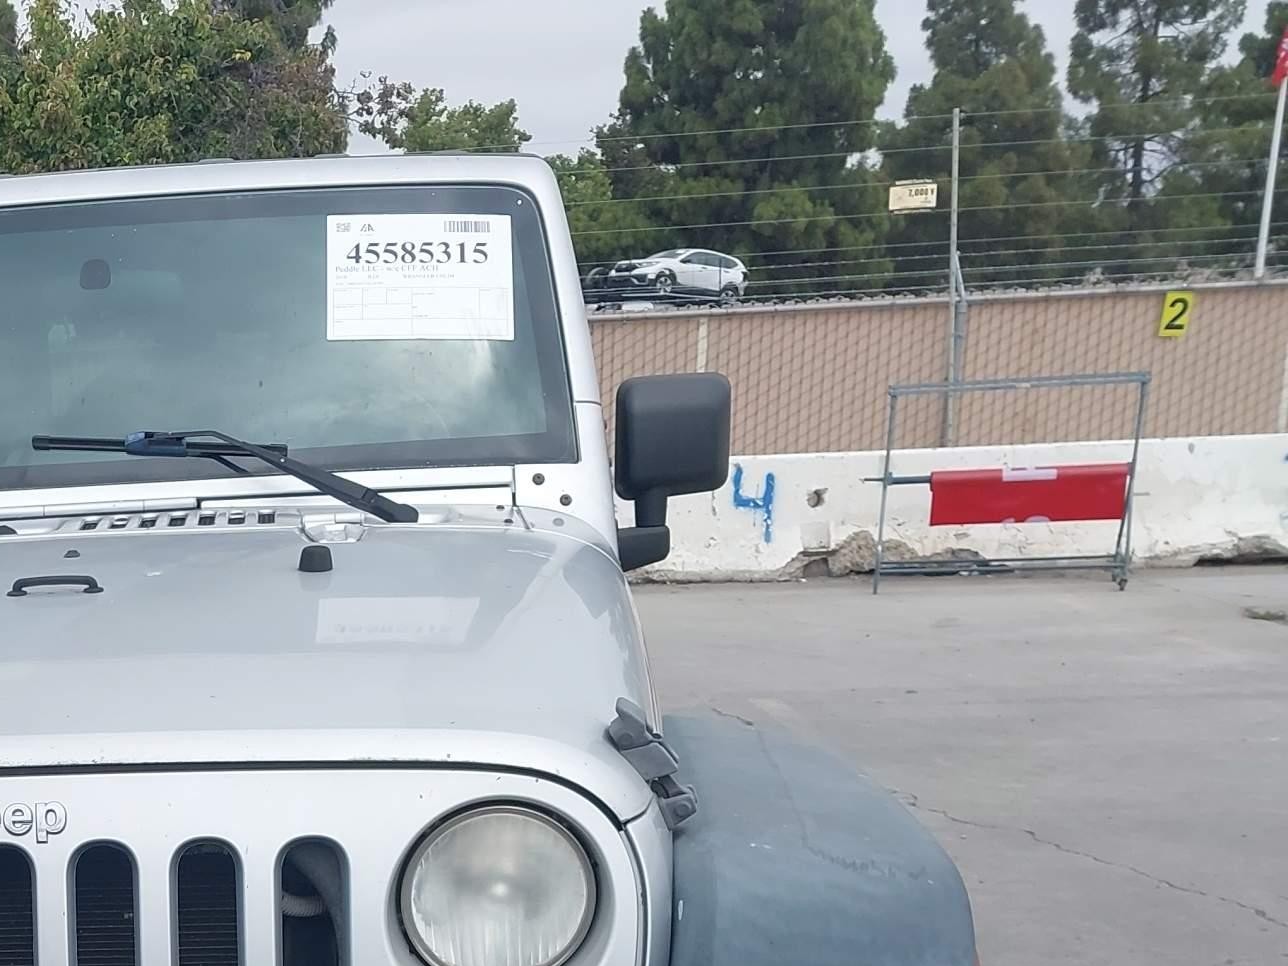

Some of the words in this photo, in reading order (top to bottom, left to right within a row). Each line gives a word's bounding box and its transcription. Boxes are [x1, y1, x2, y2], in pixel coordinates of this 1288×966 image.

[346, 241, 489, 264] 45585315
[1164, 297, 1189, 330] 2
[733, 463, 775, 543] 4
